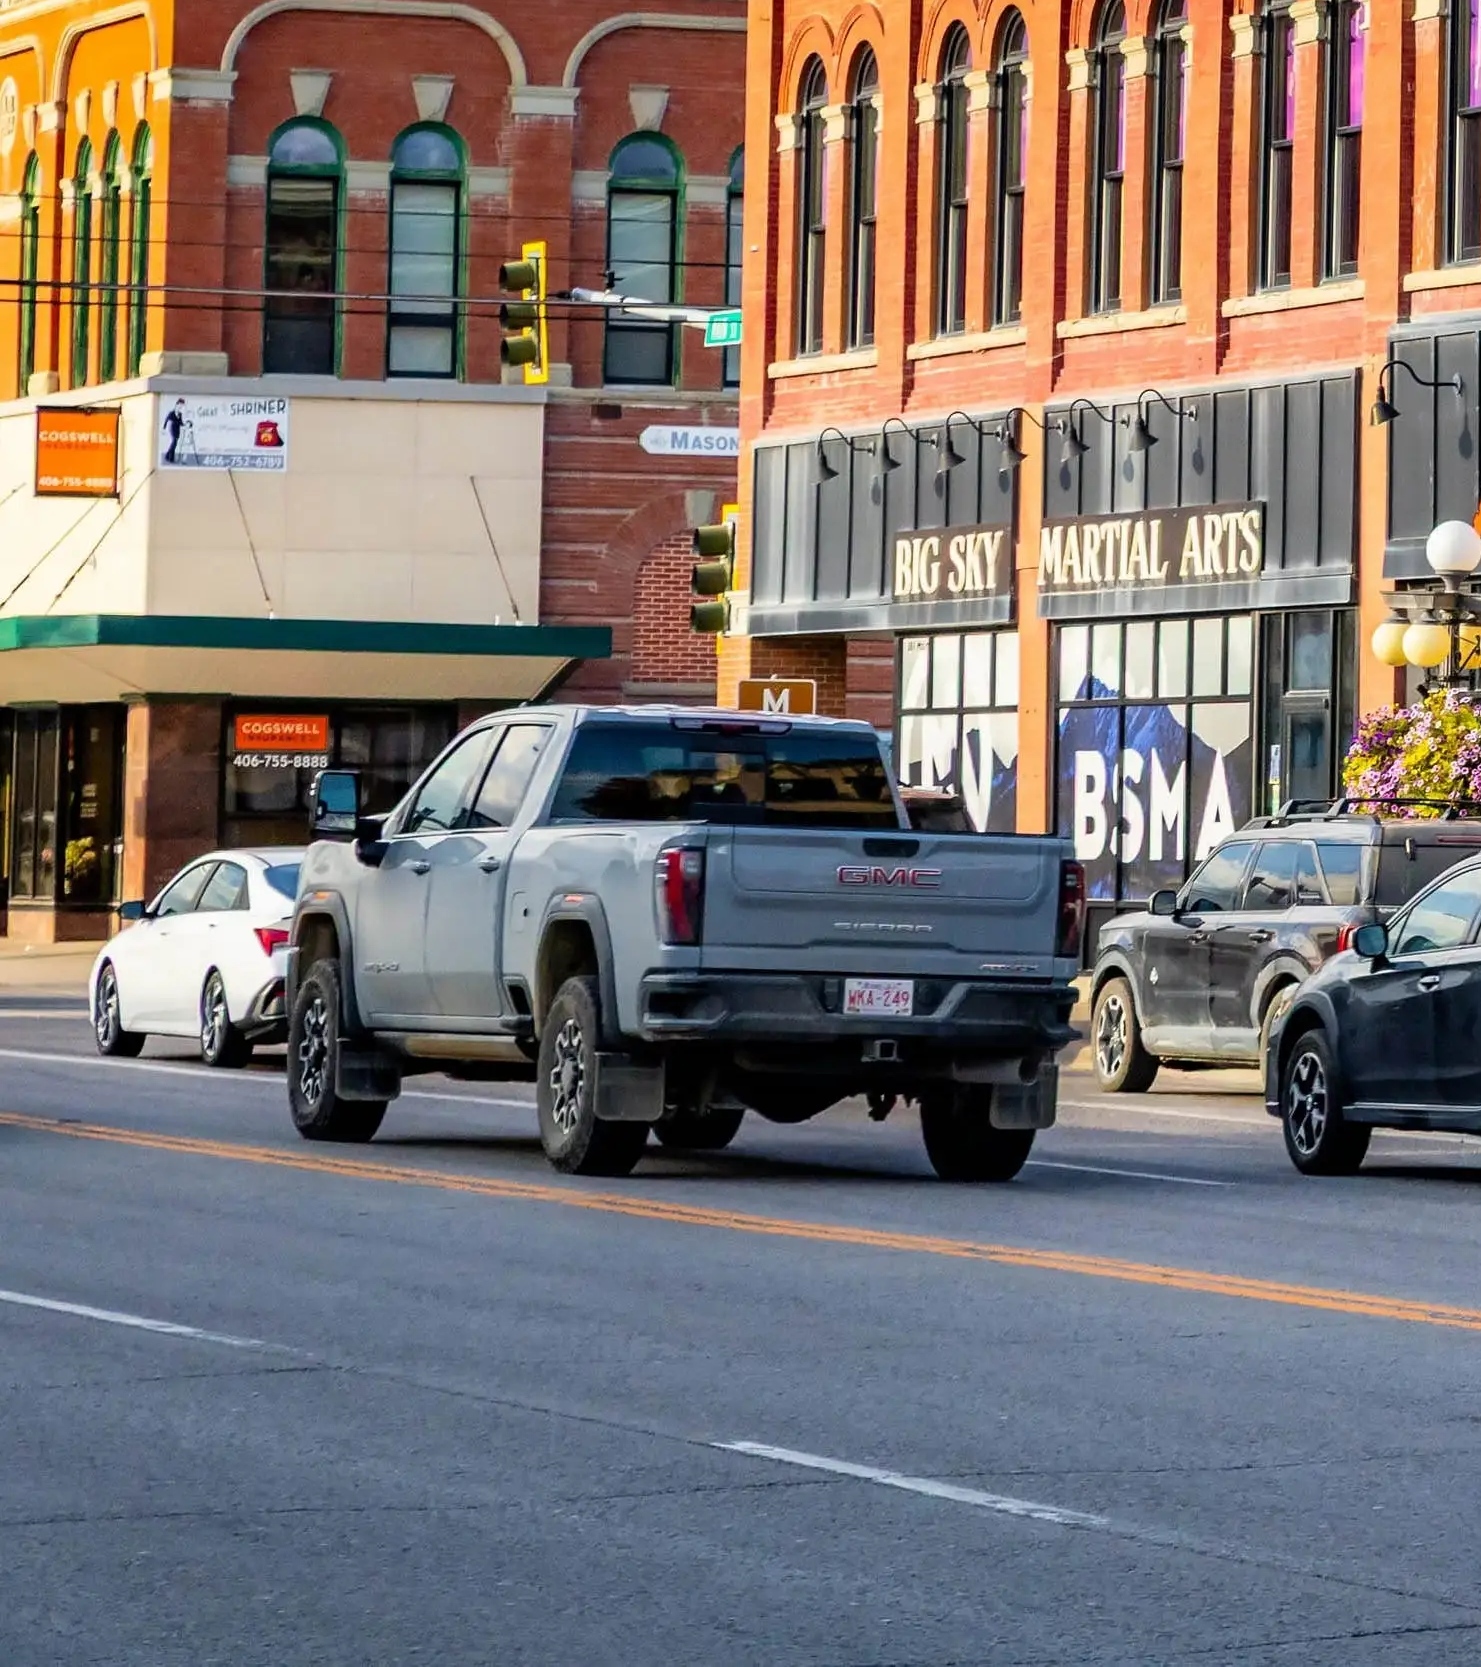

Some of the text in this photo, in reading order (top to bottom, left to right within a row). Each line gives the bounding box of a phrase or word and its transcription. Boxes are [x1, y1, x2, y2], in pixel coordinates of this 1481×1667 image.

[230, 399, 286, 416] SHRINER
[894, 509, 1262, 597] BIG SKY MARTIAL ARTS
[241, 722, 320, 735] COGSWELL
[233, 754, 329, 769] 406-755-8888
[1073, 745, 1237, 864] BSMA
[833, 865, 942, 889] GMC
[834, 921, 933, 933] SIERRA
